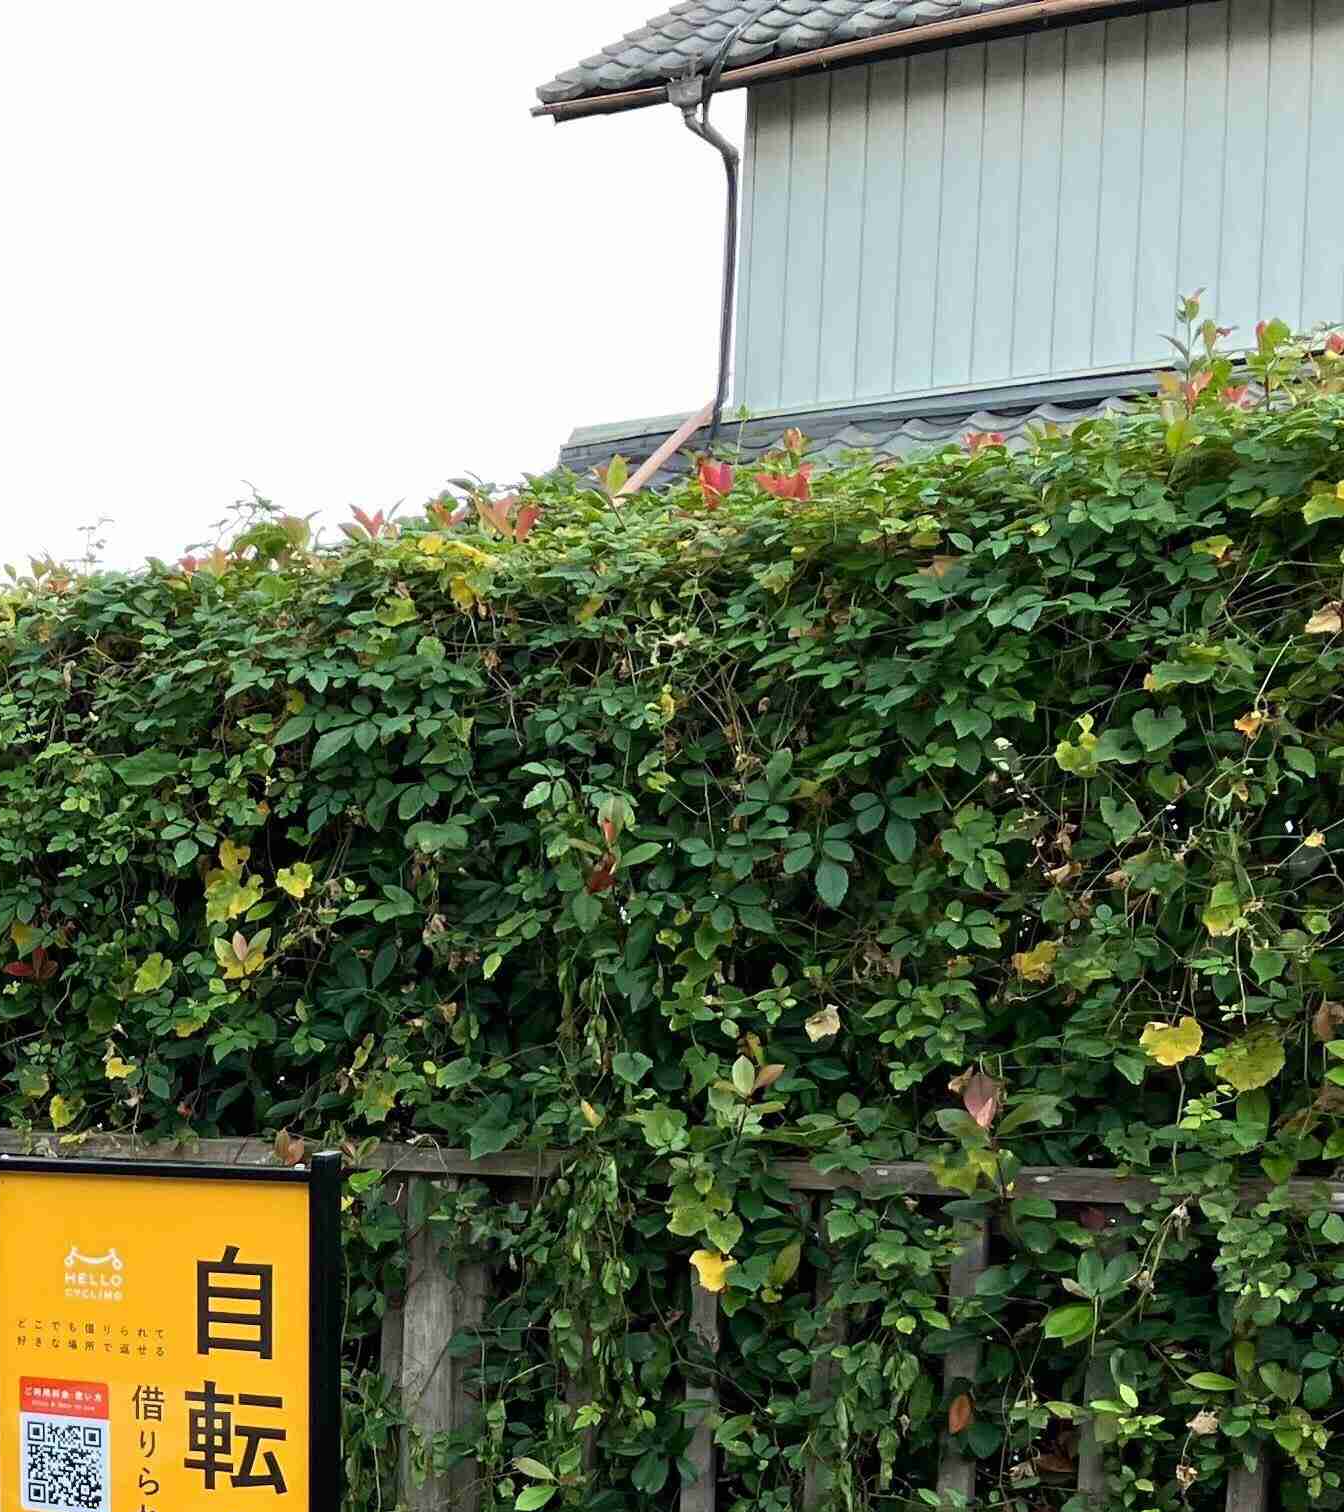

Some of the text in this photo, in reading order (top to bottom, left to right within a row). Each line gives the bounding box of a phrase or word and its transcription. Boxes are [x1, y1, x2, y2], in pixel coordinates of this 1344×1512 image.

[64, 1272, 123, 1288] HELLO
[16, 1319, 165, 1340] どこでも借りられて
[16, 1335, 166, 1358] 好きな場所で返せる
